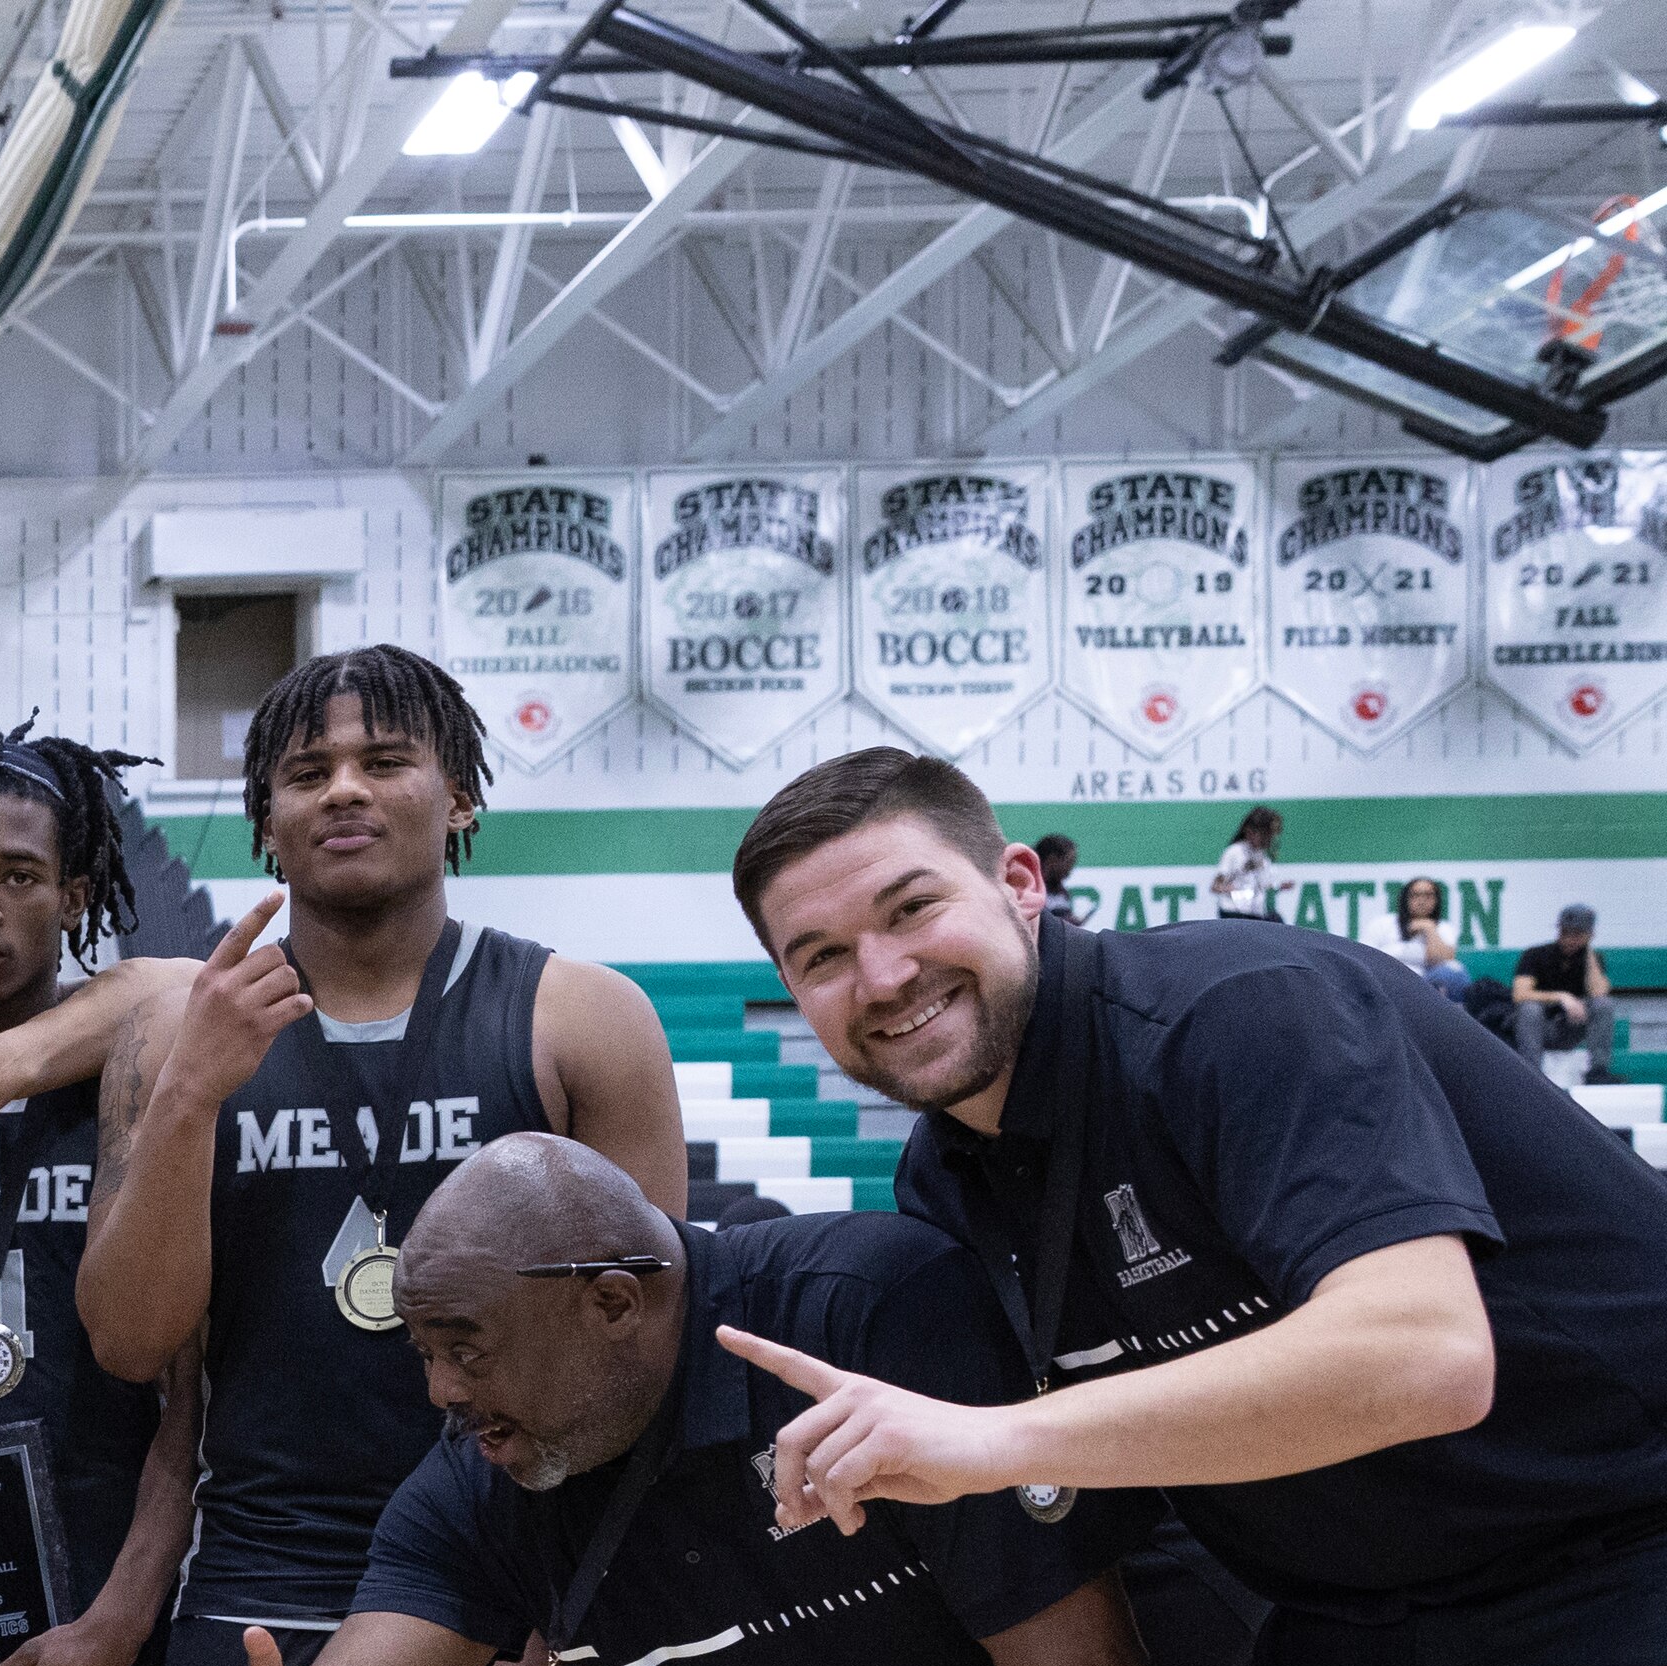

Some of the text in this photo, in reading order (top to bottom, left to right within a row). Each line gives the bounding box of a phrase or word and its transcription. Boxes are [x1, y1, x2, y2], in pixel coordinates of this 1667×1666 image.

[467, 486, 612, 525] STATE
[675, 478, 818, 522] STATE
[1088, 471, 1235, 514] STATE
[1299, 466, 1448, 510] STATE
[446, 518, 625, 583] CHAMPIONS
[1072, 506, 1249, 569] CHAMPIONS
[1277, 501, 1464, 566] CHAMPIONS
[1086, 574, 1127, 595] 20
[1304, 568, 1434, 592] 20 21
[1520, 561, 1650, 586] 20 21
[475, 588, 517, 617] 20
[685, 591, 728, 619] 20
[1555, 605, 1621, 629] FALL
[666, 634, 821, 674] BOCCE
[877, 628, 1030, 668] BOCCE
[1075, 625, 1247, 648] VOLLEYBALL
[1283, 624, 1458, 647] FIELD HOCKEY
[1116, 1248, 1193, 1289] BASKETBALL
